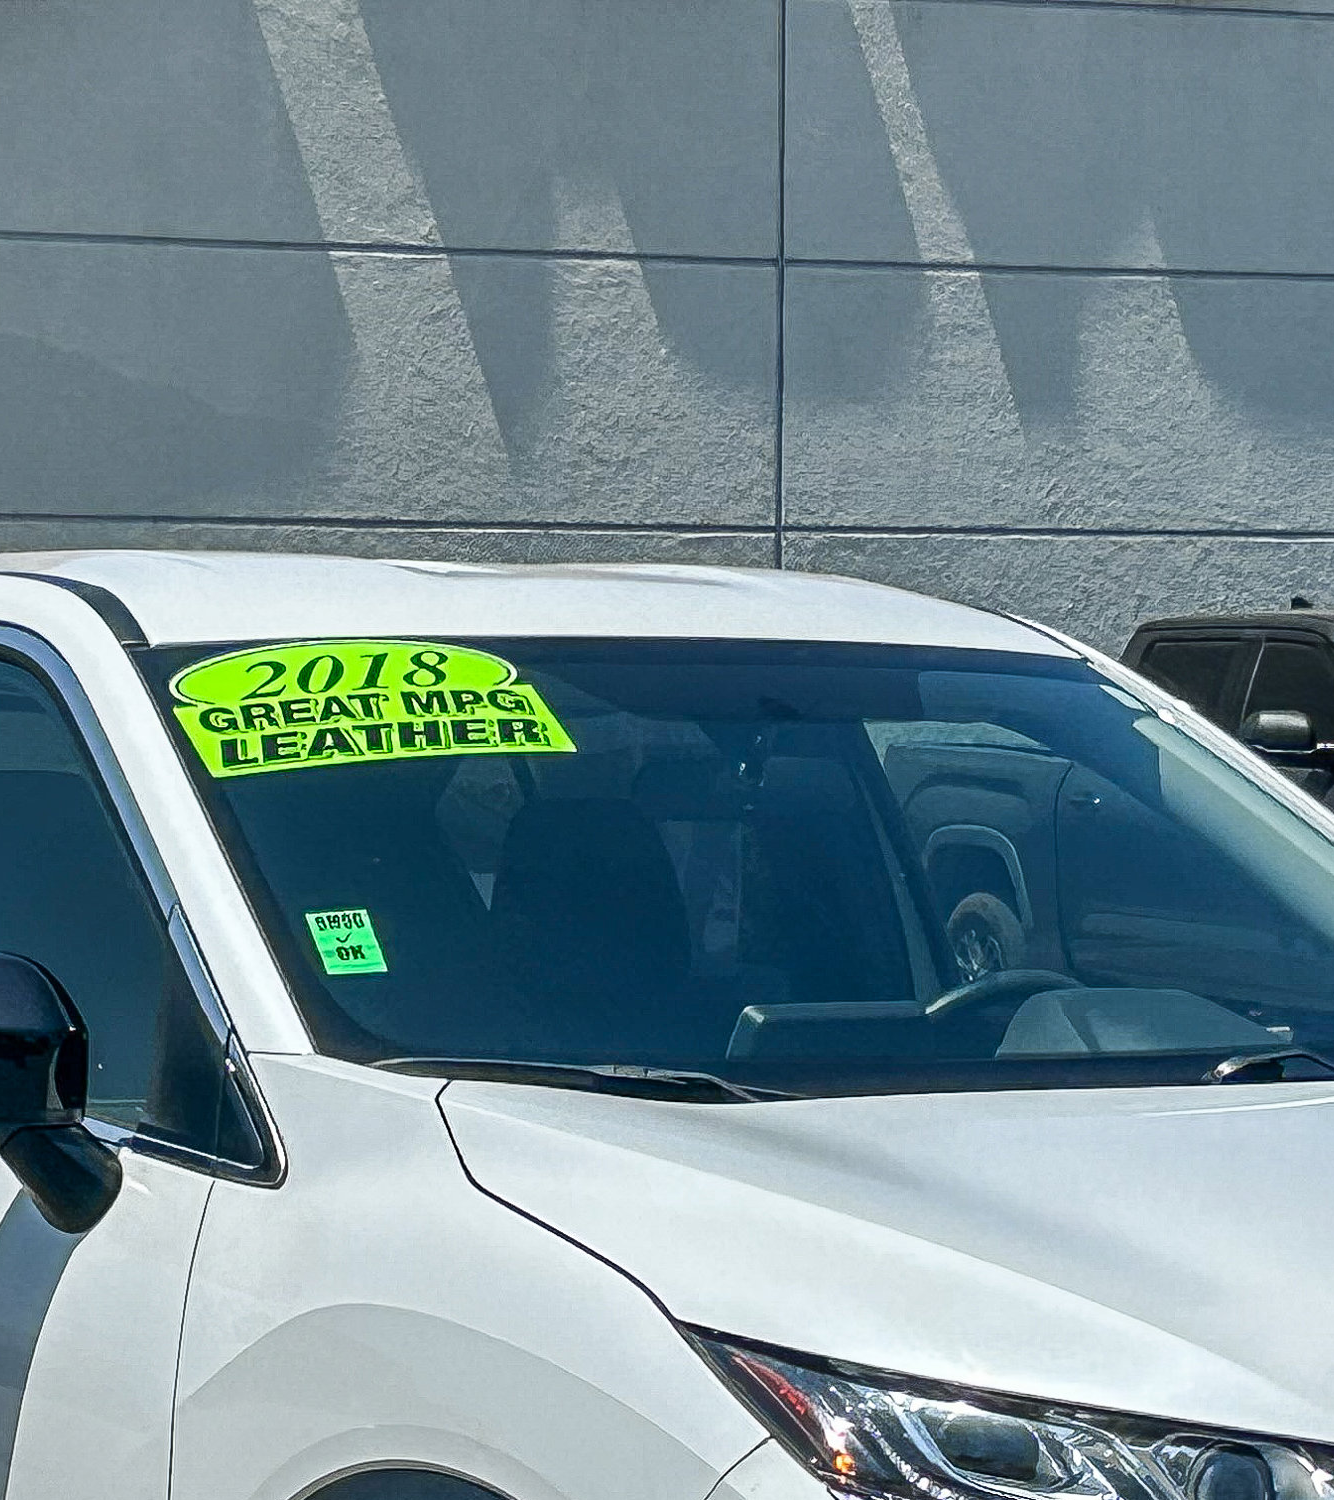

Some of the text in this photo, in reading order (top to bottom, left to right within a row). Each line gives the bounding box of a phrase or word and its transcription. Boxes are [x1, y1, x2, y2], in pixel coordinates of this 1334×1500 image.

[242, 651, 449, 701] 2018
[198, 688, 534, 733] GREAT MPG
[220, 720, 549, 770] LEATHER
[335, 945, 366, 961] OK
